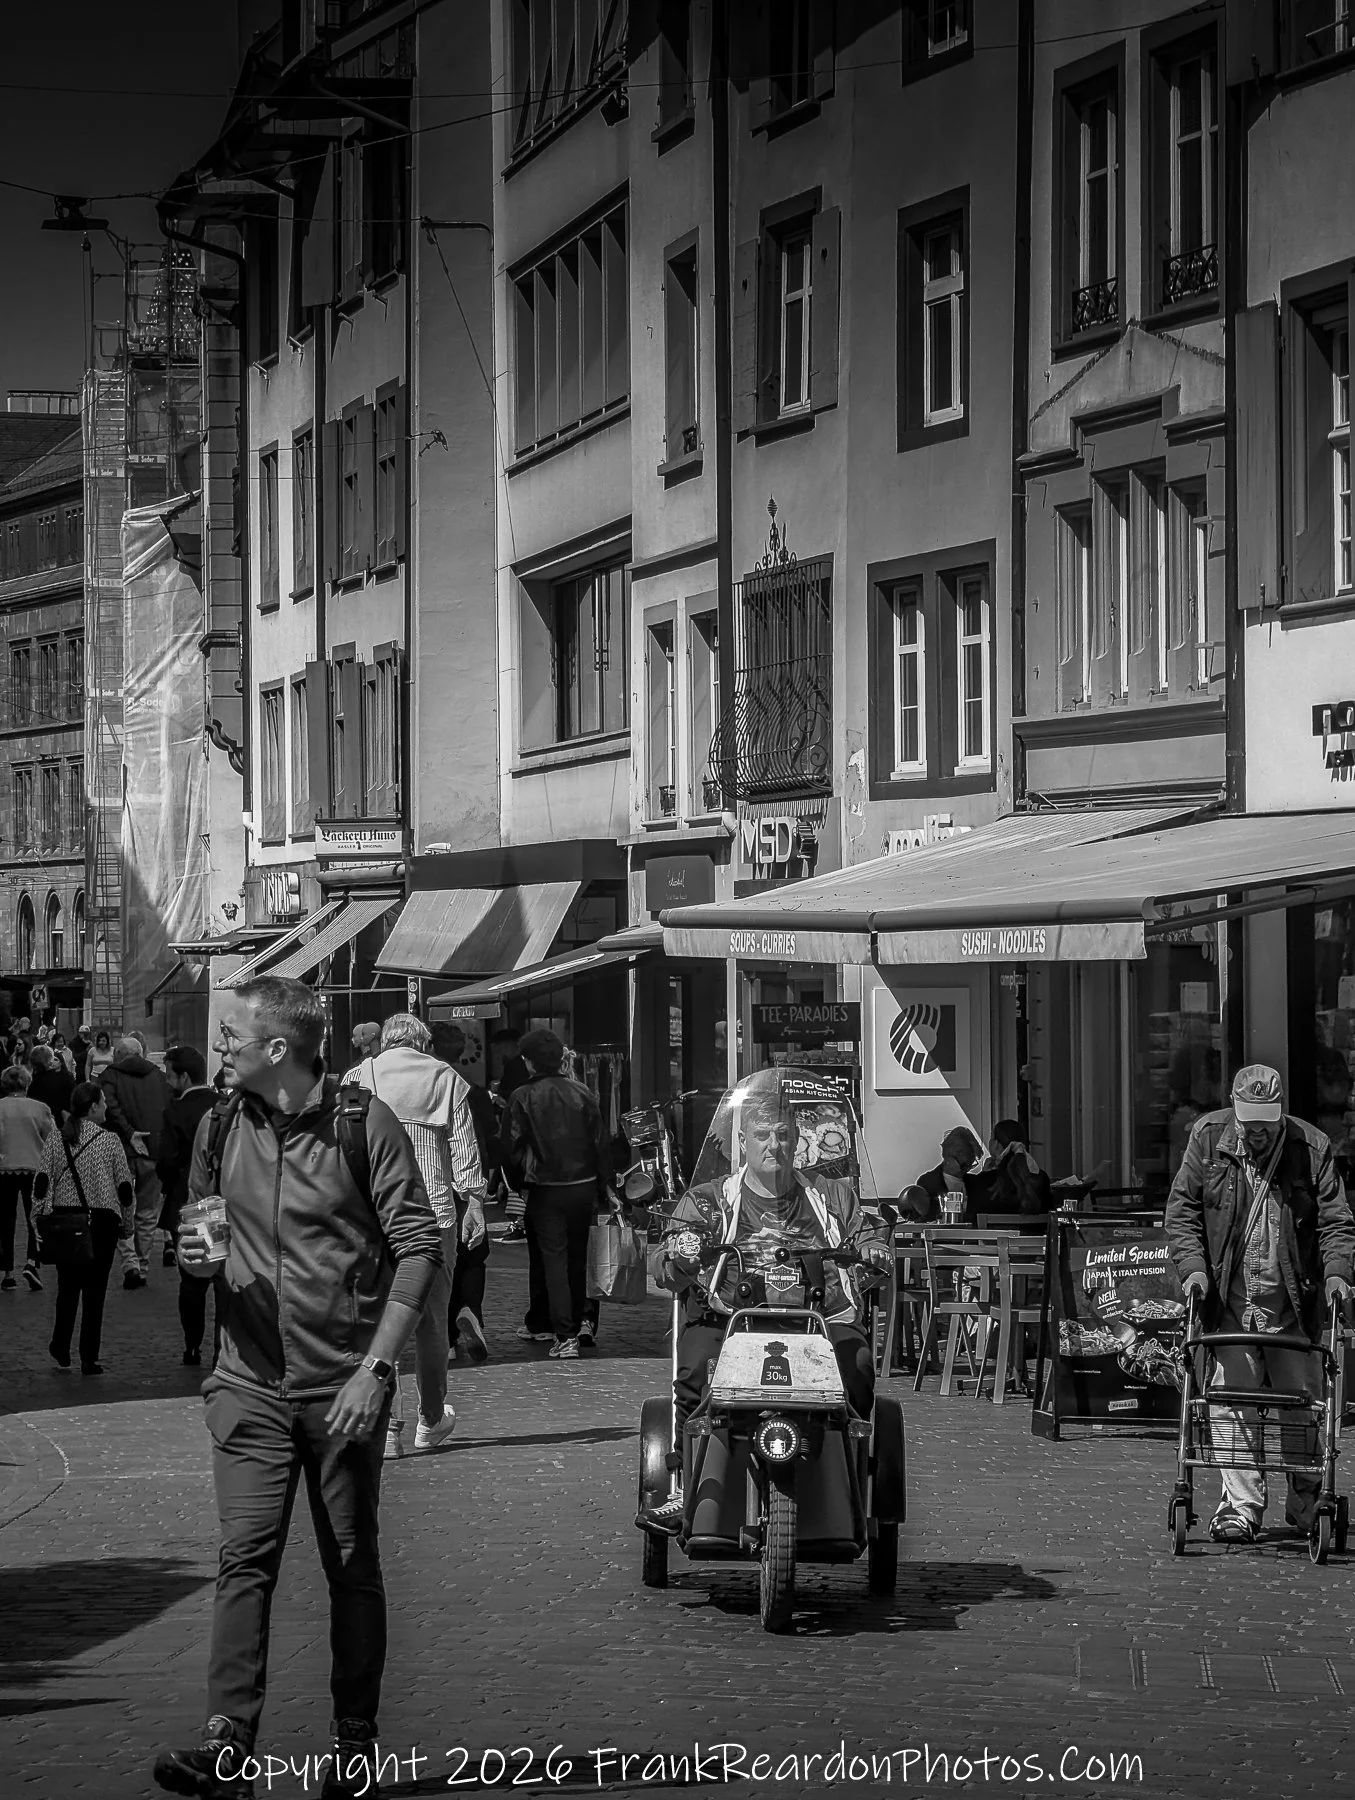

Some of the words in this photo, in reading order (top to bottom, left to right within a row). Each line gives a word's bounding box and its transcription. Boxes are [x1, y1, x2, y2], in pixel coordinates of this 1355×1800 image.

[730, 932, 756, 953] SOUPS
[761, 933, 796, 955] CURRIES
[961, 931, 991, 956] SUSHI
[998, 928, 1046, 954] NOODLES
[759, 1005, 849, 1023] TEE-PARADIES
[806, 1090, 838, 1099] KITCHEN
[1085, 1247, 1127, 1266] Limited
[1128, 1245, 1170, 1264] Special
[1112, 1270, 1118, 1278] X
[1118, 1268, 1138, 1277] ITALY
[1139, 1267, 1166, 1276] FUSION
[1098, 1289, 1117, 1305] NEU!
[766, 1371, 788, 1382] 30kg
